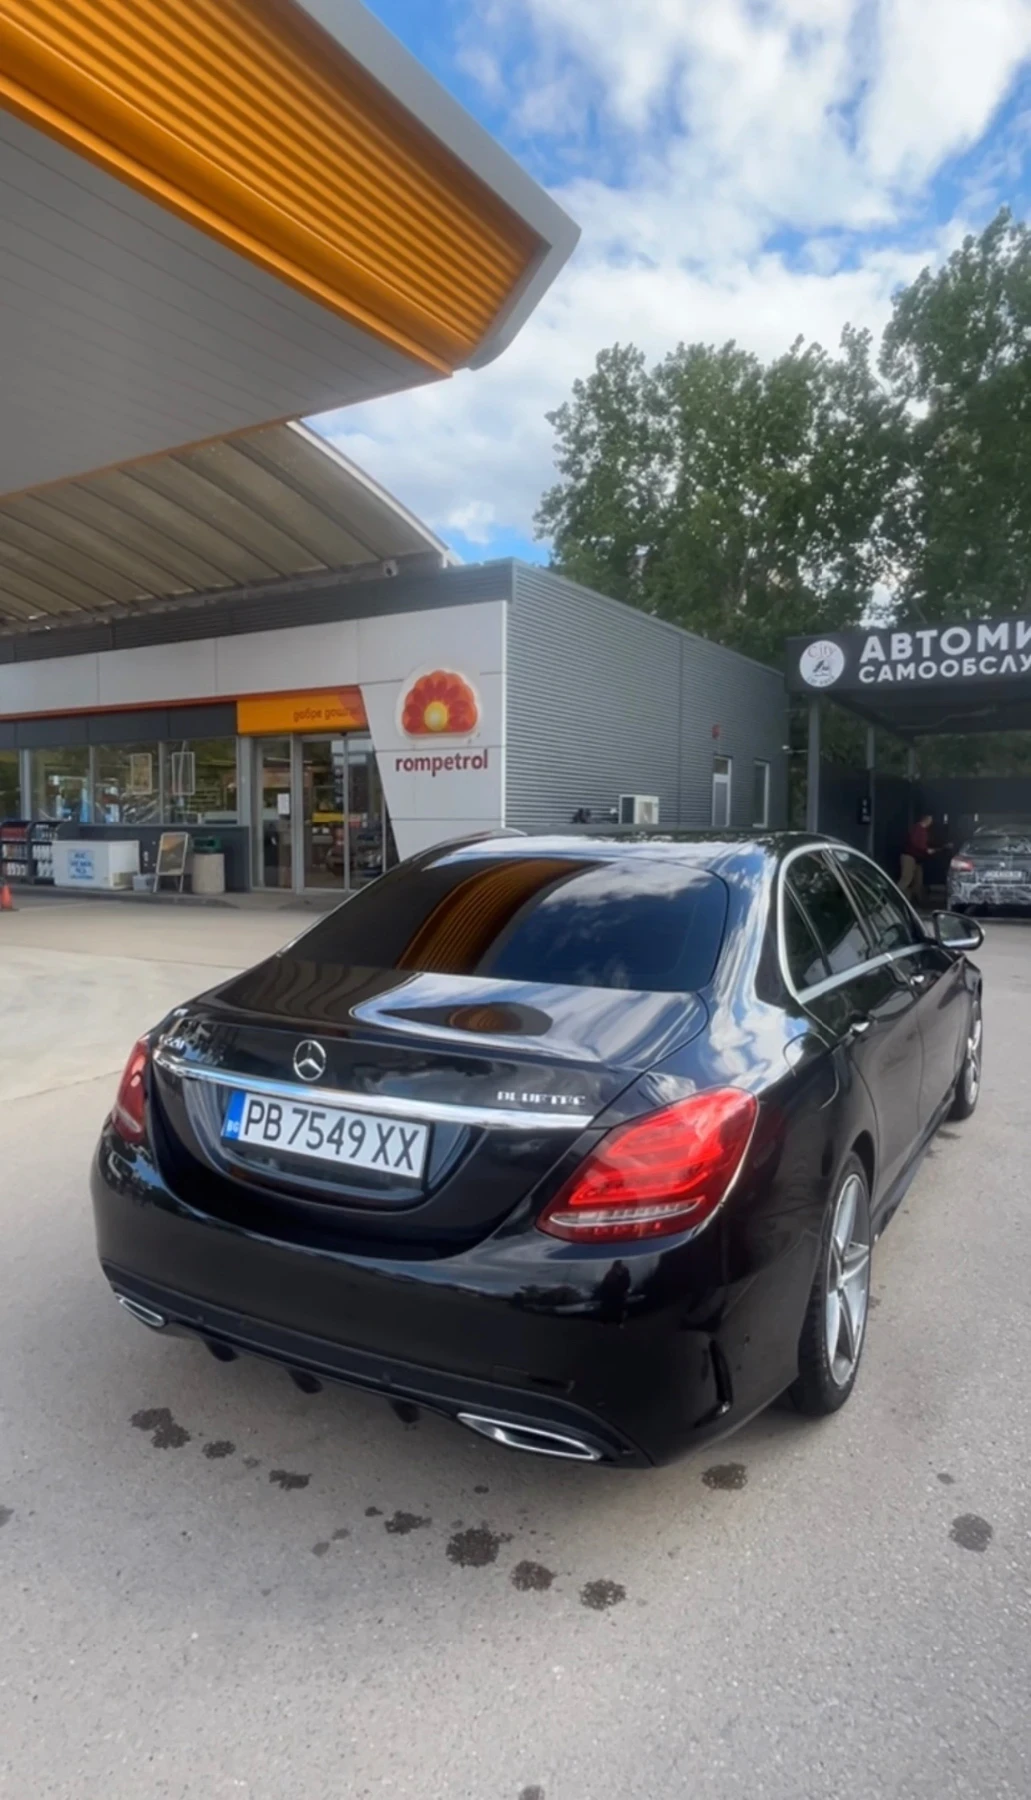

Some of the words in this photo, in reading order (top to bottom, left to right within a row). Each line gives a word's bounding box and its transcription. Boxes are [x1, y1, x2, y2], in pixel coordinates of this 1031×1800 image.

[395, 749, 489, 777] rompetrol
[244, 1099, 283, 1142] PB
[287, 1107, 367, 1159] 7549
[371, 1123, 420, 1171] XX
